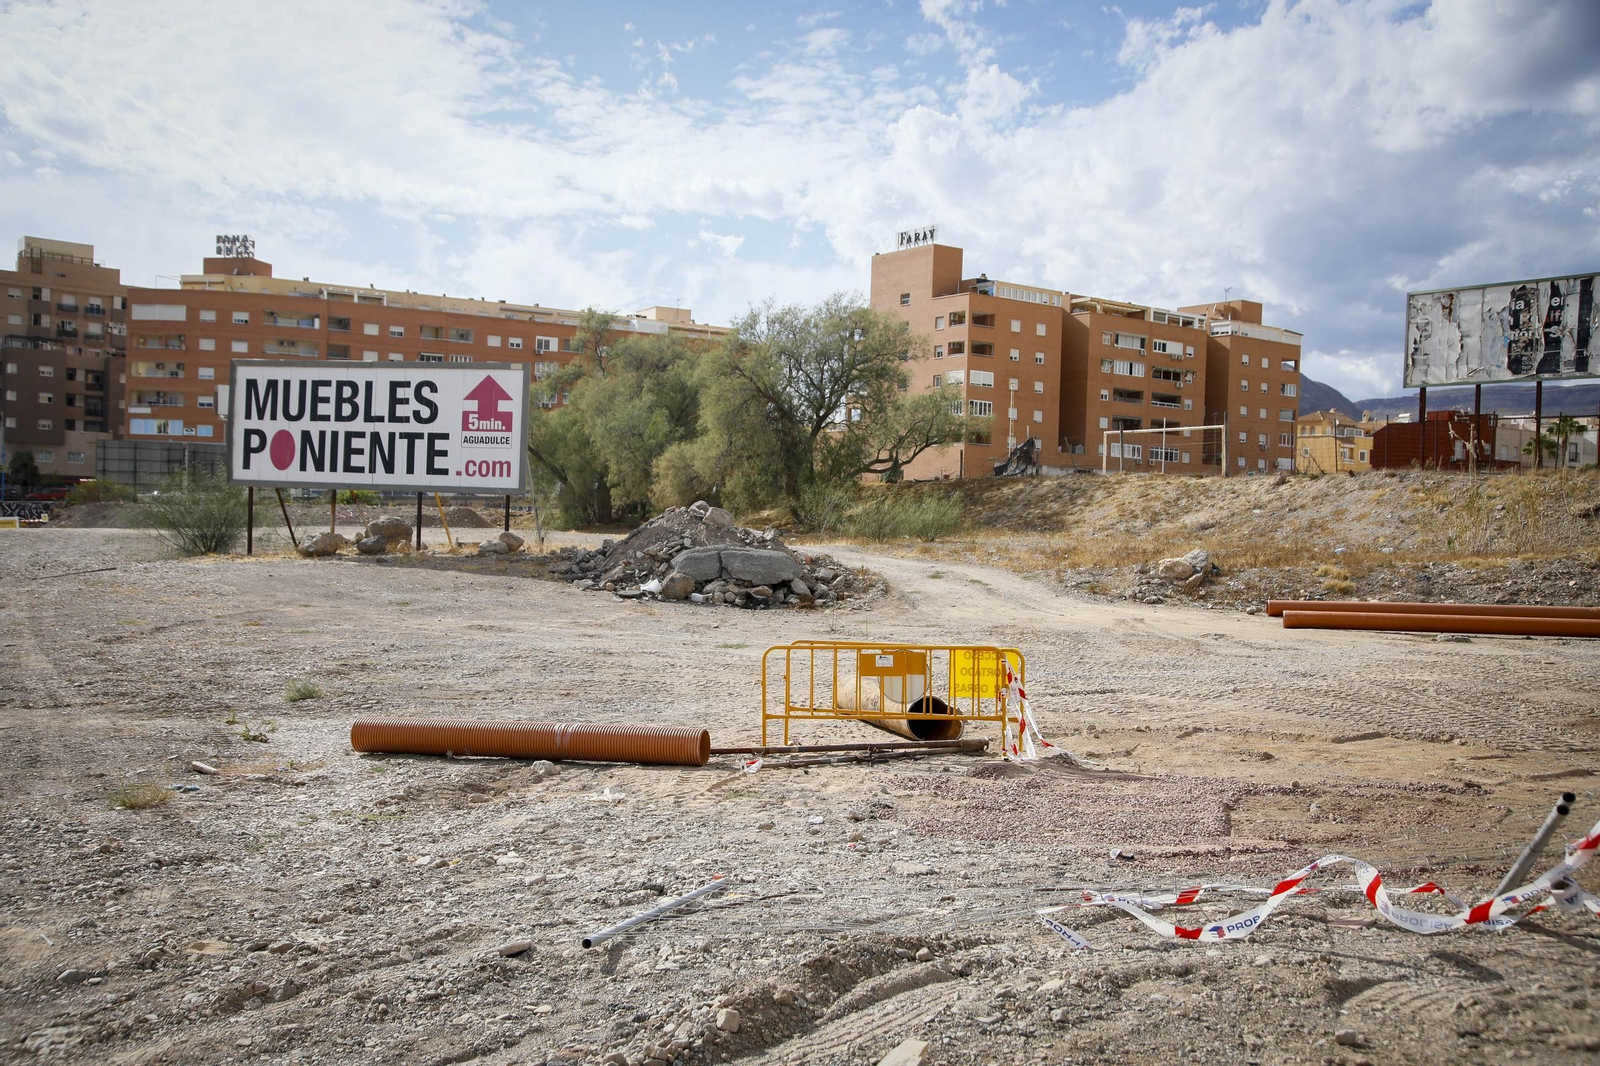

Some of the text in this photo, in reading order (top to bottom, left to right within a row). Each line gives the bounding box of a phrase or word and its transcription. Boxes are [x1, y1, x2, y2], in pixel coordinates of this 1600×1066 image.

[244, 378, 439, 424] MUEBLES
[468, 413, 506, 431] 5min.
[242, 428, 511, 478] PONIENTE .com
[463, 435, 511, 445] AGUADULCE
